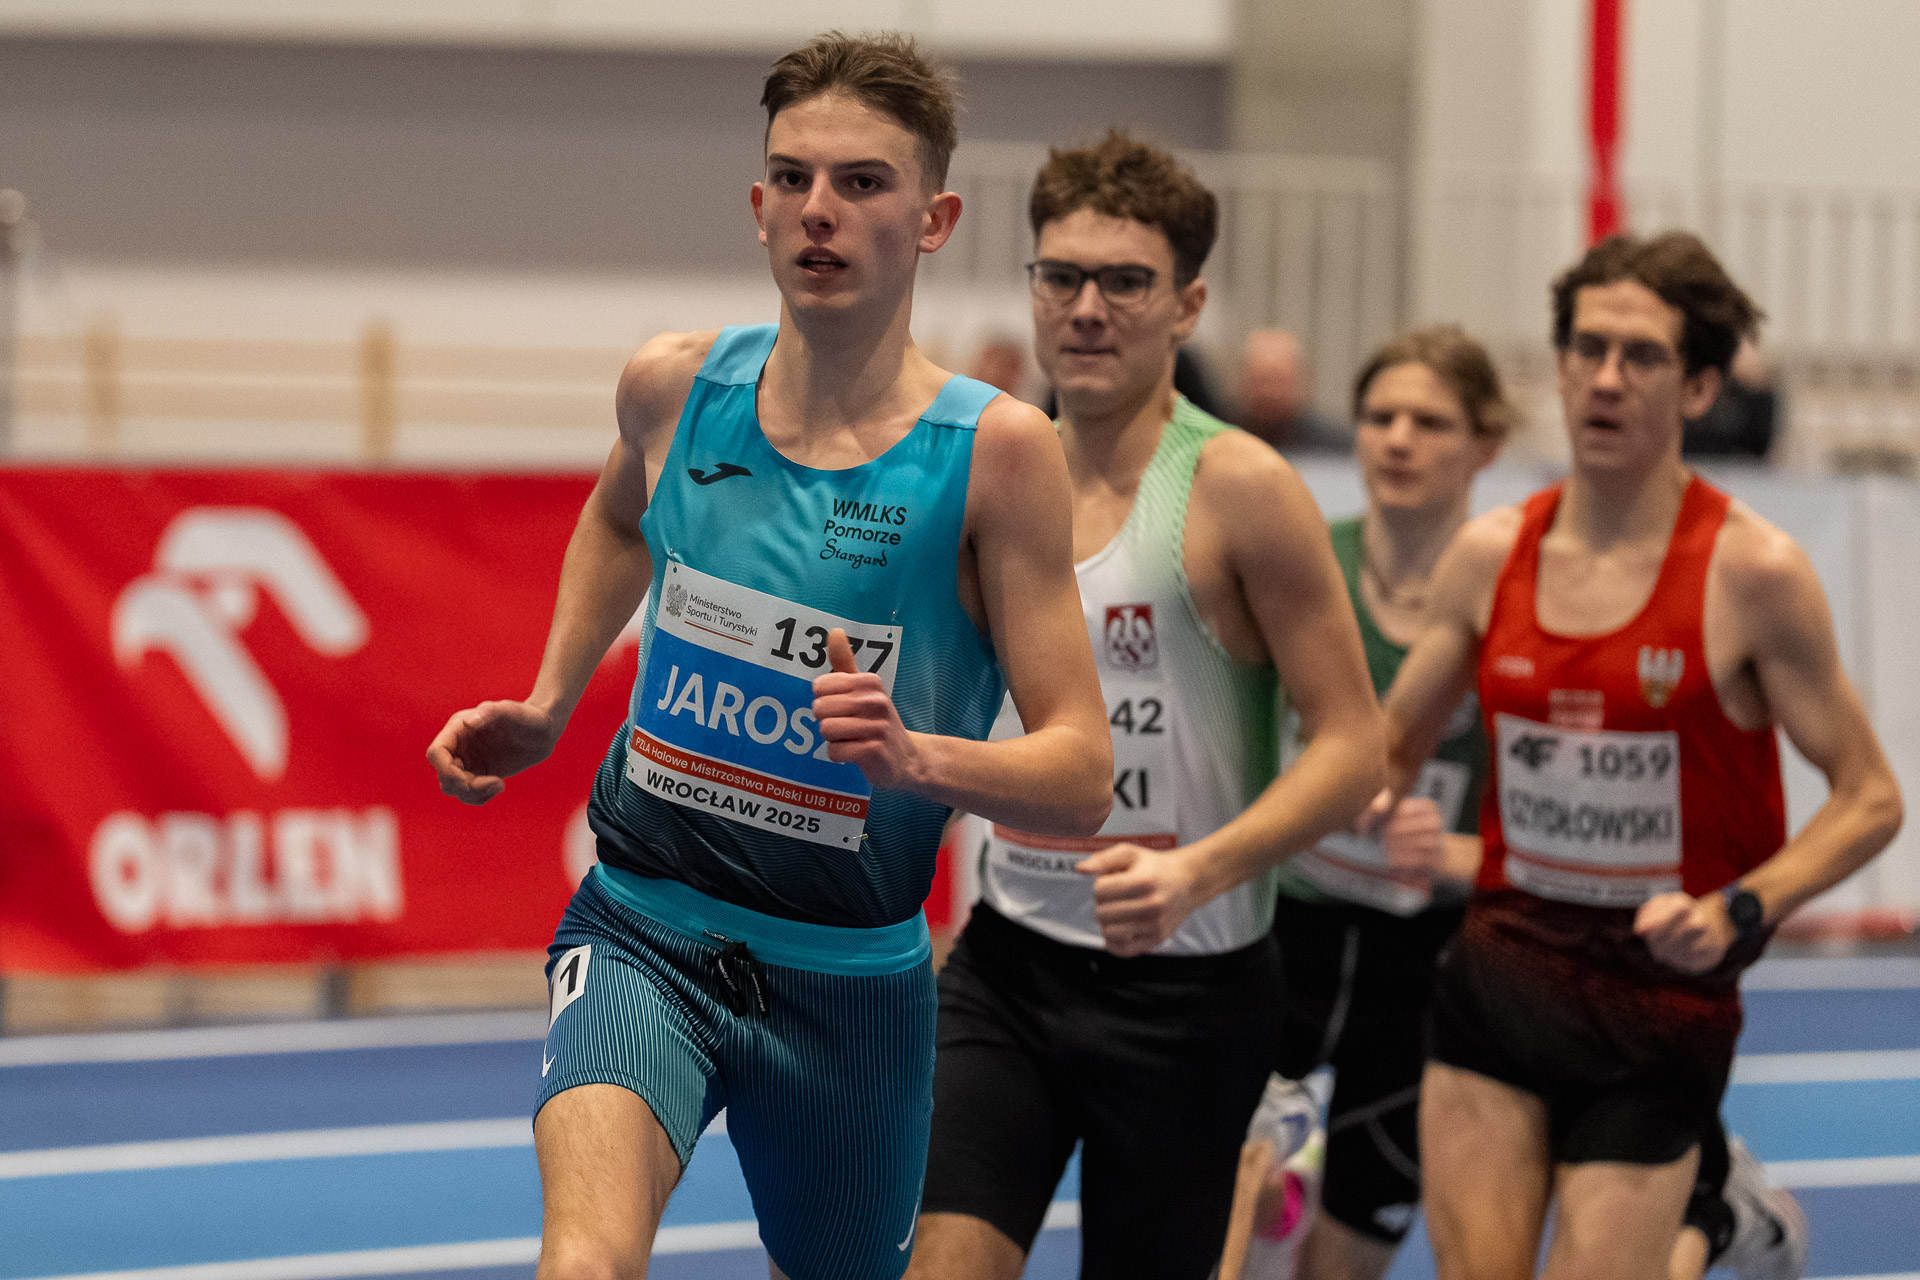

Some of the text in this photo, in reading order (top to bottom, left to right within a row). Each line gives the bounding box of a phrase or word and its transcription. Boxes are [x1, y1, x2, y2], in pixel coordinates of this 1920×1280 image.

[832, 498, 907, 526] WMLKS
[823, 520, 901, 546] Pomorze
[820, 538, 888, 569] Stargard
[686, 605, 712, 622] Sportu
[719, 616, 758, 637] Turystyki
[689, 593, 742, 619] Ministerstwo
[656, 664, 845, 765] JAROS
[1110, 697, 1164, 735] 42
[635, 736, 861, 814] PZLA Halowe Mistrzostwa Polski U18 i U20
[1579, 744, 1672, 782] 1059
[646, 768, 821, 834] WROCŁAW 2025
[91, 808, 402, 934] ORLEN
[559, 953, 581, 997] 1
